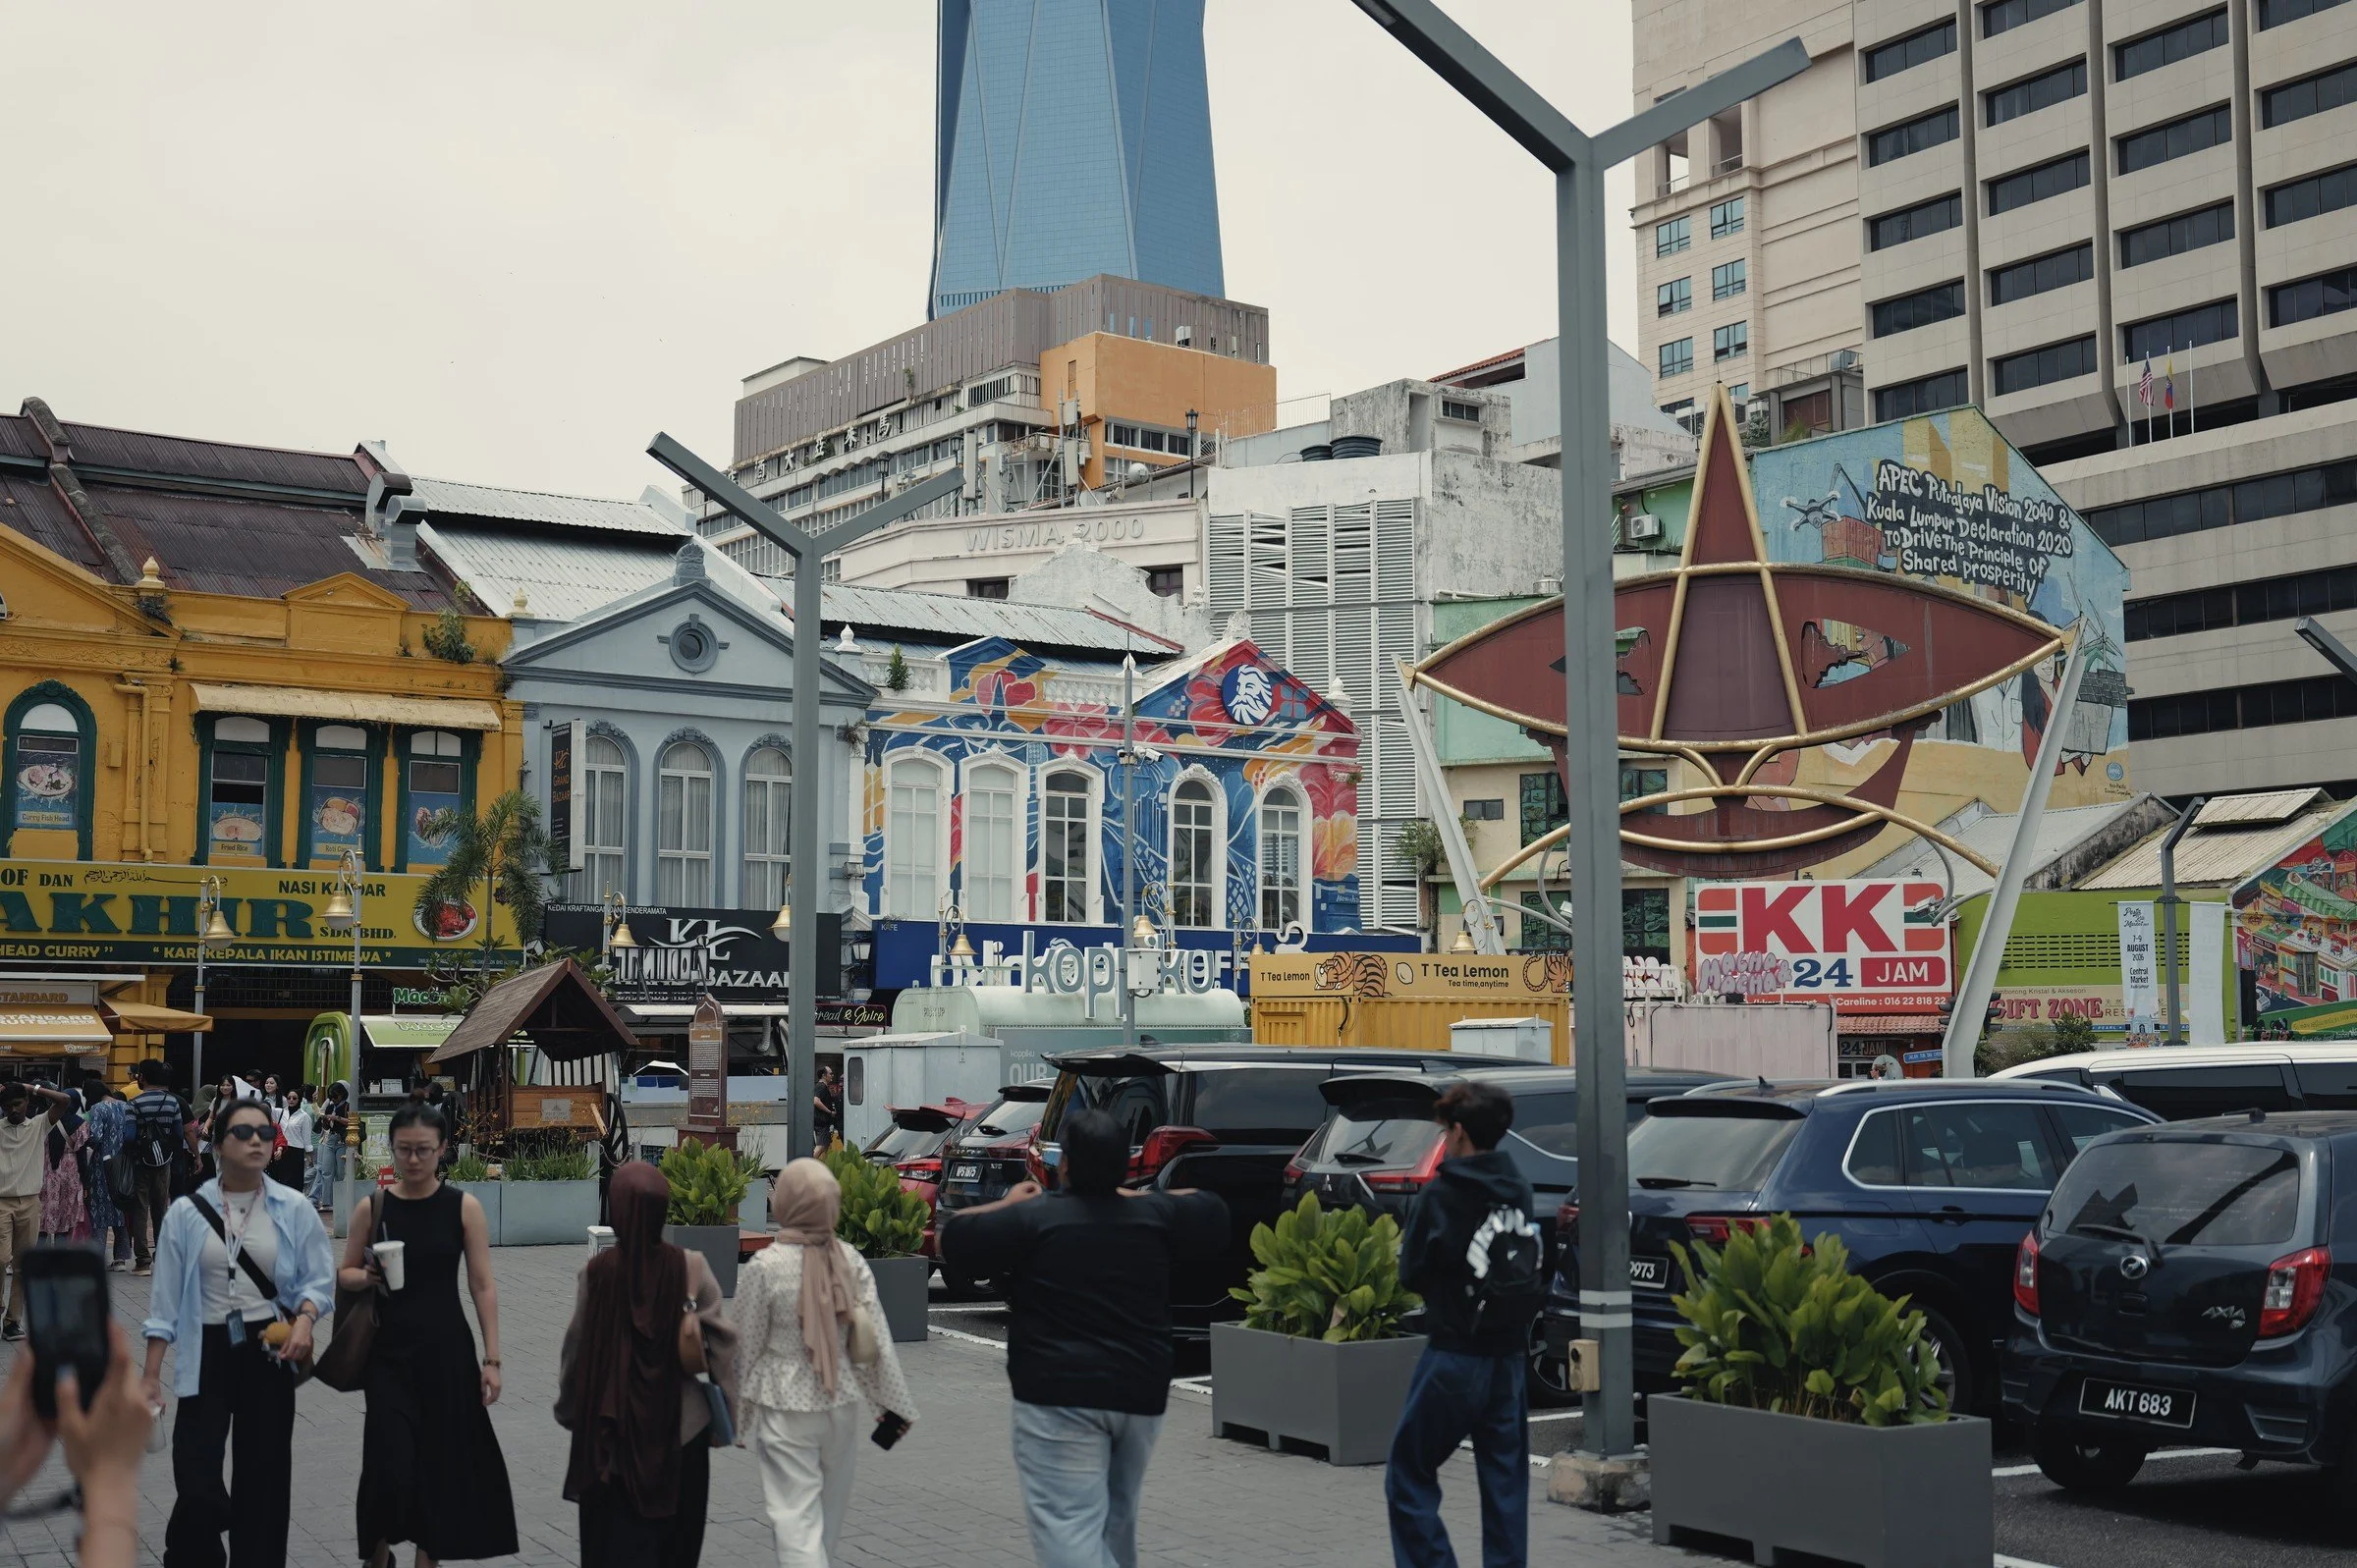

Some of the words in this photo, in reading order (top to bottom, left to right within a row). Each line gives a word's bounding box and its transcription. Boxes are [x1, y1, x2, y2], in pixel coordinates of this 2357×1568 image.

[1879, 463, 1922, 496] APEC
[1926, 475, 1983, 517] Putrajaya
[2024, 502, 2055, 523] 2040
[2057, 507, 2071, 530] &
[1867, 495, 1905, 522] Kuala
[1910, 508, 1954, 532] Lumpur
[1957, 518, 2034, 547] Declaration
[2038, 536, 2072, 556] 2020
[967, 522, 1065, 552] WISMA
[1077, 517, 1144, 543] 2000
[1902, 549, 1957, 574] Shared
[1967, 540, 2022, 573] Principle
[22, 813, 40, 823] Curry
[41, 814, 53, 823] Fish
[221, 843, 237, 852] Fried
[1, 868, 28, 887] OF
[39, 873, 74, 888] DAN
[279, 880, 315, 894] NASI
[360, 927, 397, 940] BHD.
[44, 946, 100, 958] CURRY
[205, 947, 266, 960] KEPALA
[270, 949, 307, 961] IKAN
[2126, 944, 2149, 952] AUGUST
[698, 970, 789, 989] BAZAA
[1261, 972, 1265, 982] T
[1265, 971, 1282, 982] Tea
[1284, 970, 1310, 982] Lemon
[1421, 963, 1430, 977] T
[1435, 963, 1458, 978] Tea
[1463, 963, 1509, 979] Lemon
[1793, 957, 1853, 988] 24
[1876, 961, 1929, 983] JAM
[1836, 997, 1877, 1006] Careline
[1885, 997, 1900, 1005] 016
[1902, 997, 1914, 1005] 22
[1916, 997, 1932, 1005] 818
[1933, 997, 1946, 1005] 22
[1990, 998, 2041, 1020] GIFT
[2048, 997, 2104, 1019] ZONE
[844, 1009, 852, 1022] &
[853, 1005, 885, 1025] Juice
[1840, 1041, 1862, 1055] 24
[1864, 1040, 1885, 1055] JAM
[2201, 1305, 2246, 1320] AXIA
[2105, 1387, 2137, 1412] AKT
[2138, 1392, 2172, 1416] 683
